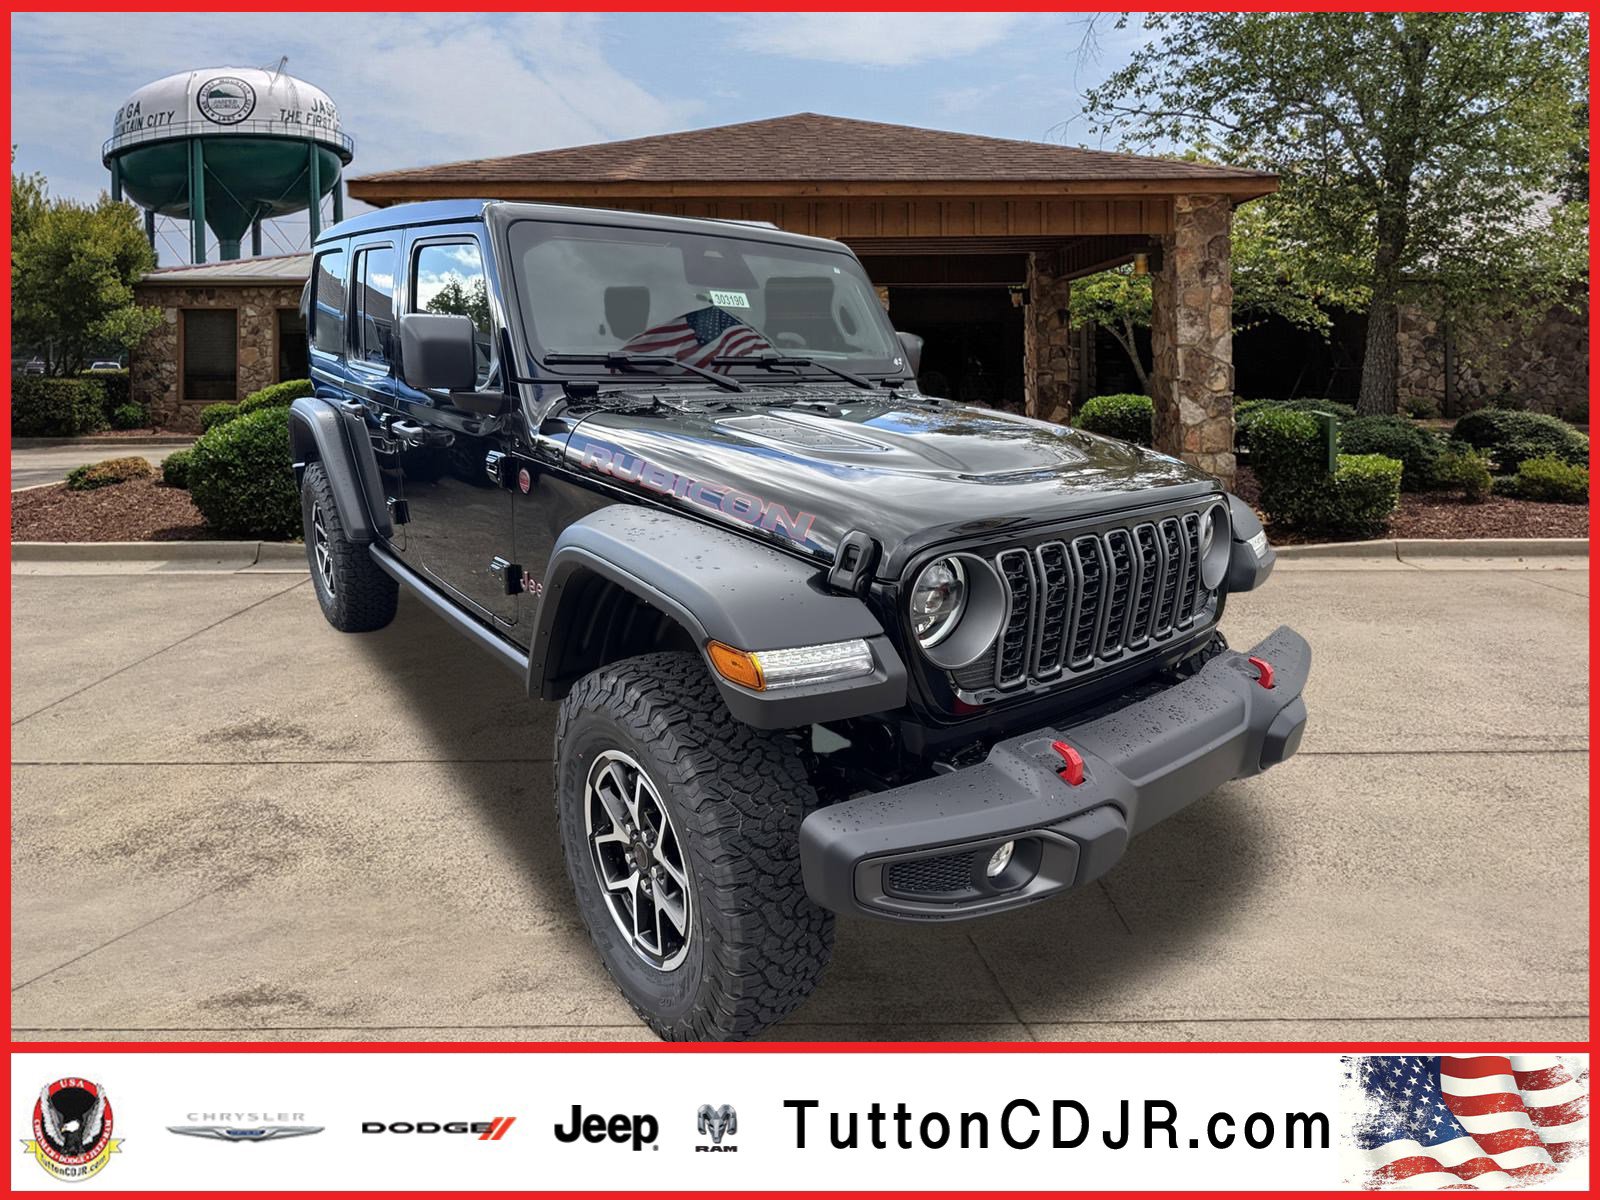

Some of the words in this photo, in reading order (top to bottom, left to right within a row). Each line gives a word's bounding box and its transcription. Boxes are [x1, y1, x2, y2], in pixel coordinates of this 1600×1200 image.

[126, 100, 141, 119] GA
[147, 110, 175, 128] CITY
[280, 109, 302, 124] THE
[306, 112, 332, 130] FIRST
[714, 292, 745, 307] 303190
[580, 442, 816, 543] RUBICON
[520, 570, 543, 598] Jee
